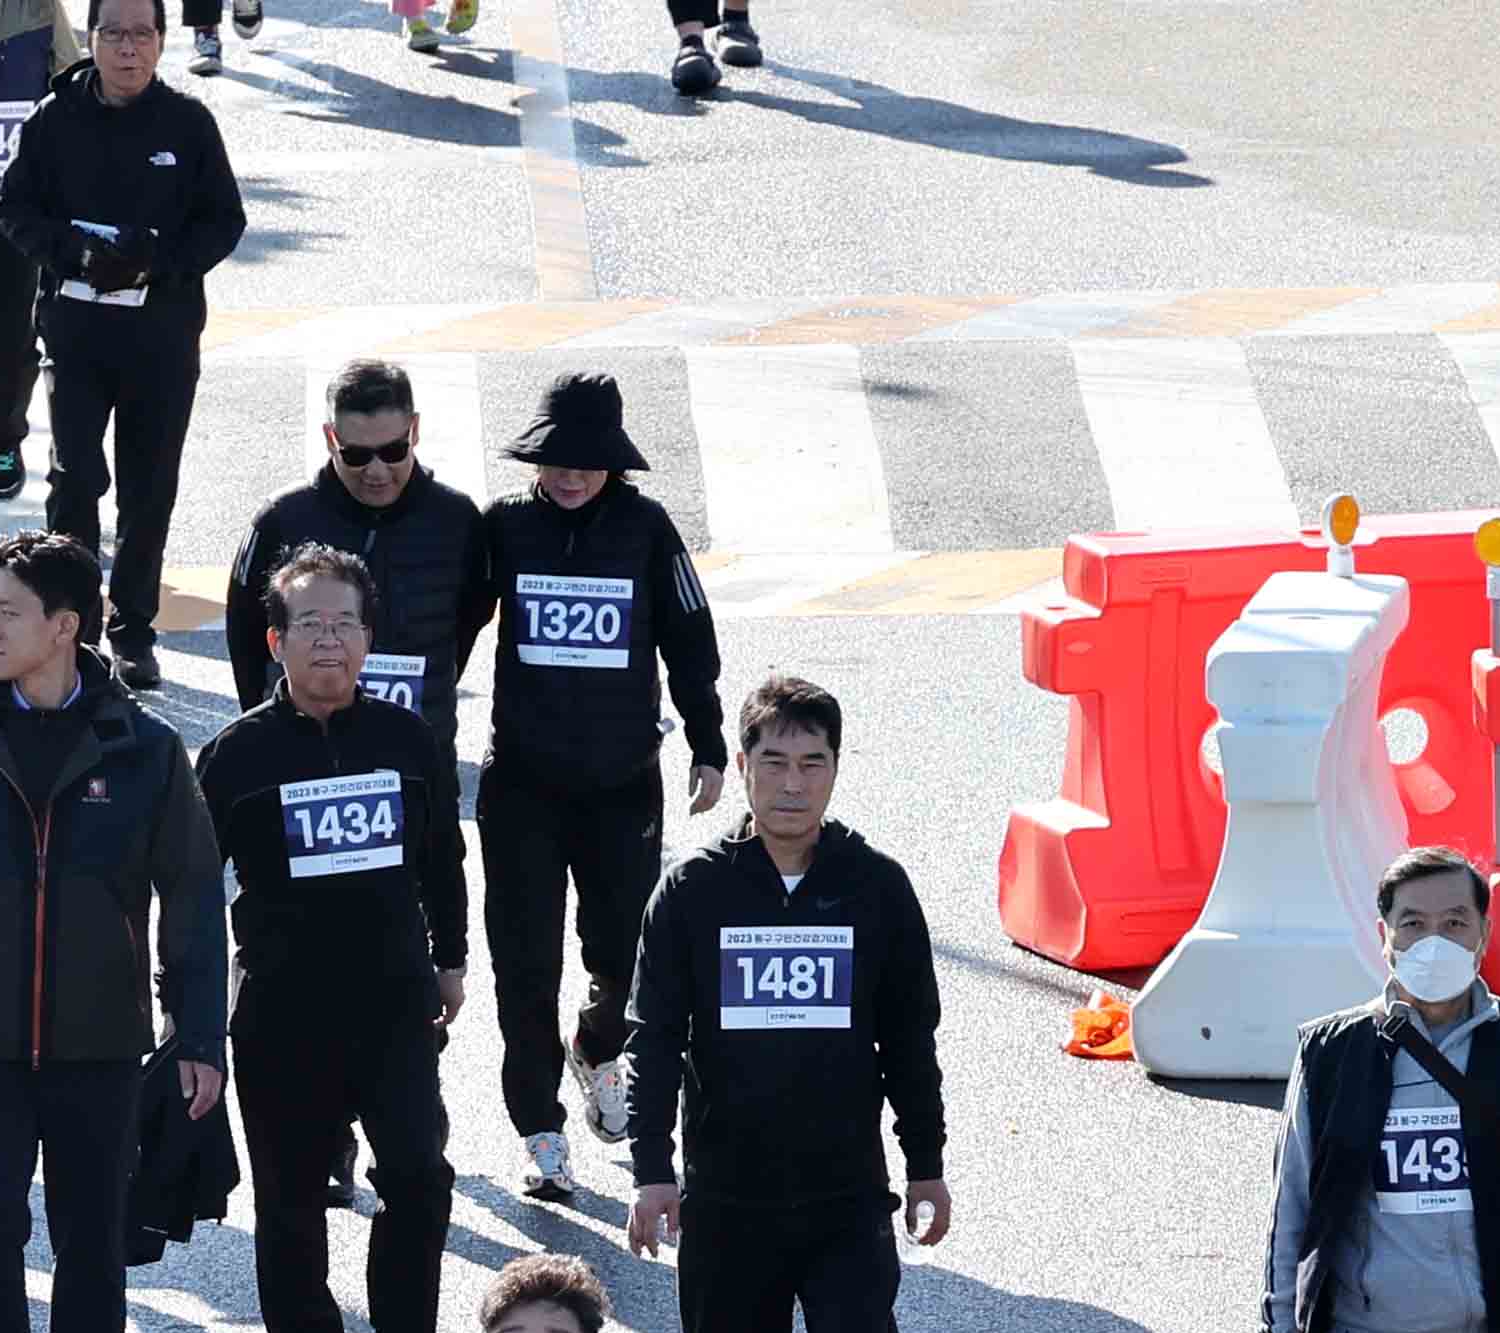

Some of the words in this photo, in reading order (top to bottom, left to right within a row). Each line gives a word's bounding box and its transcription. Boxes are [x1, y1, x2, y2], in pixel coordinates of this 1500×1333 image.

[525, 599, 621, 643] 1320
[286, 787, 311, 800] 2023
[294, 799, 396, 849] 1434
[727, 934, 752, 945] 2023
[737, 955, 835, 1000] 1481
[1379, 1136, 1469, 1184] 143
